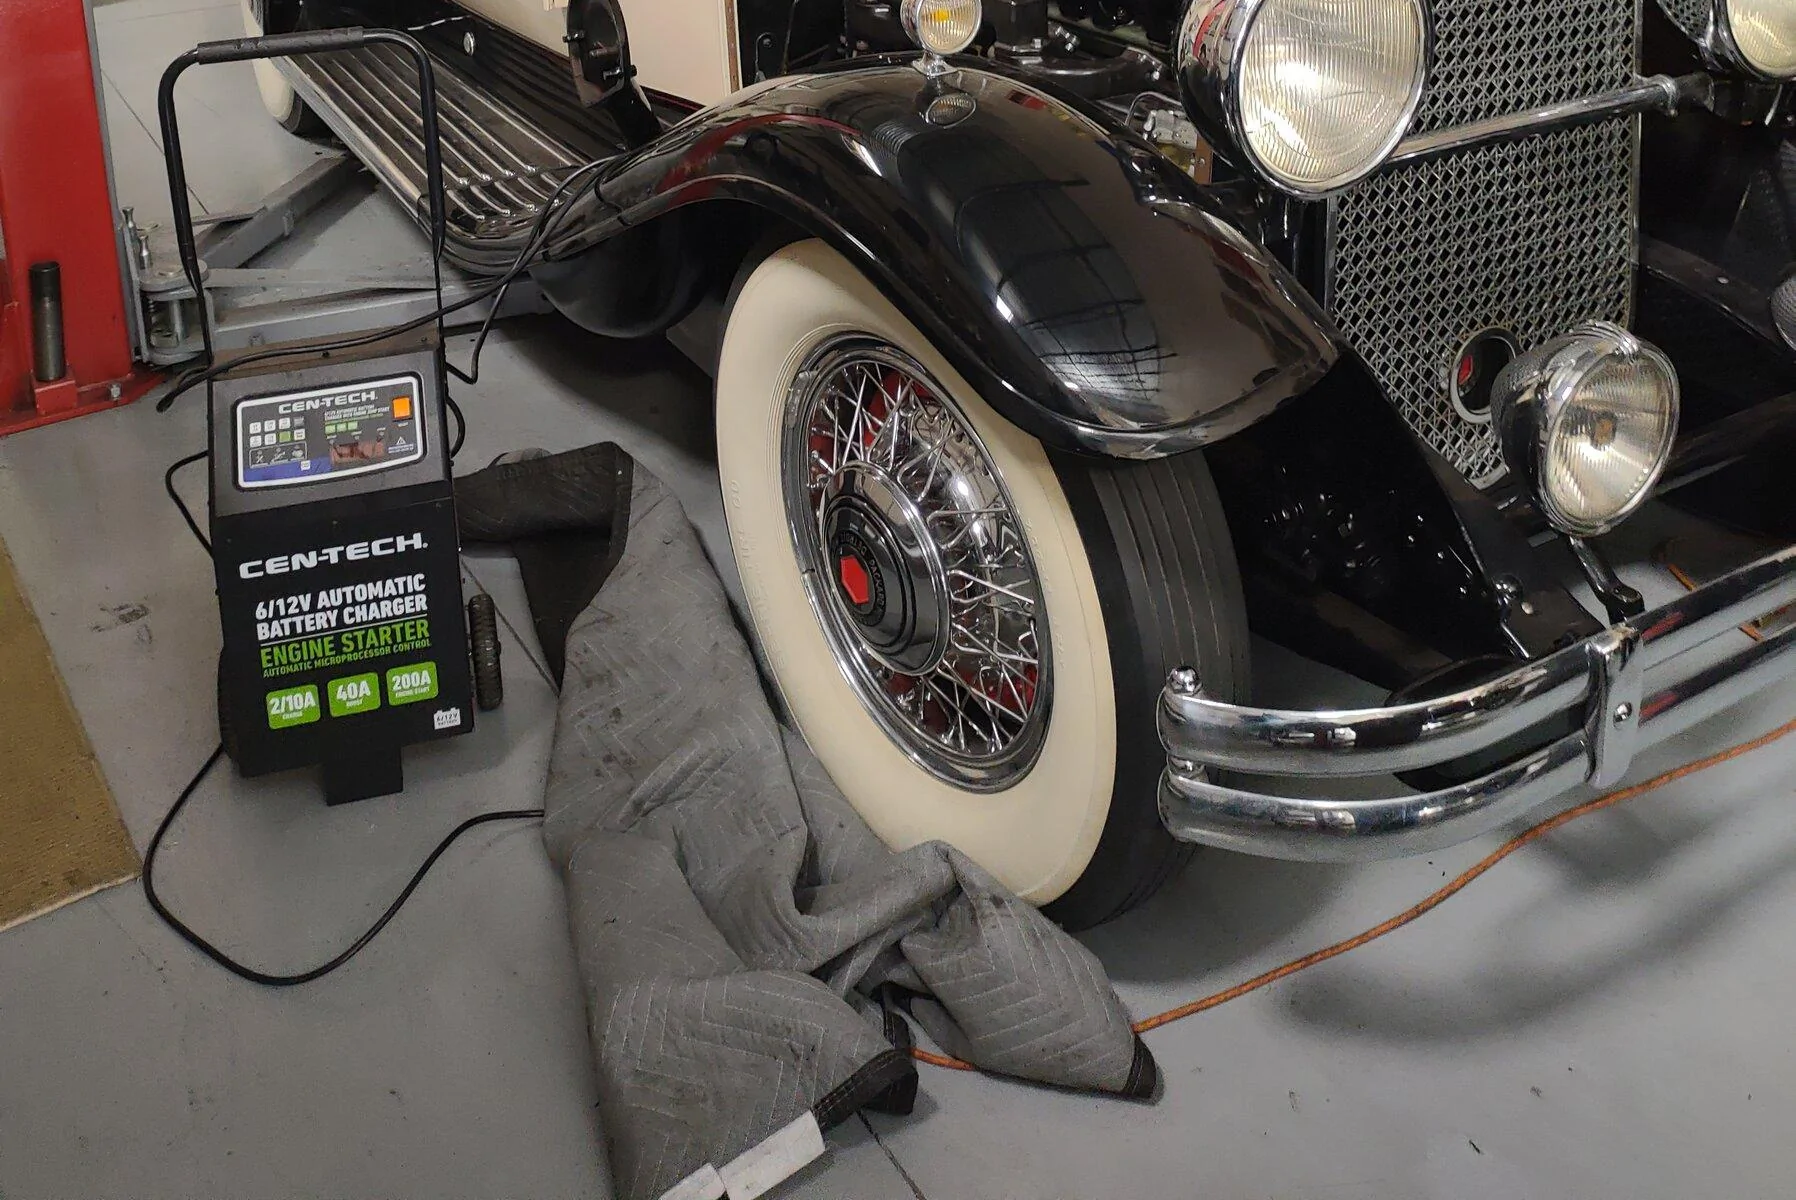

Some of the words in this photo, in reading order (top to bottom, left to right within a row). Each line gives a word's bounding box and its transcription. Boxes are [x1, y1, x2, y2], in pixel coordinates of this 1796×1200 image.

[255, 593, 311, 620] 6/12V
[317, 573, 426, 610] AUTOMATIC
[256, 609, 339, 641] BATTERY
[343, 594, 427, 625] CHARGER
[260, 636, 335, 669] ENGINE
[341, 619, 430, 653] STARTER
[263, 659, 313, 679] AUTOMATIC
[313, 646, 391, 670] MICROPROCESSOR
[393, 639, 432, 655] CONTROL
[336, 680, 371, 701] 40A
[392, 670, 431, 692] 200A
[269, 691, 316, 715] 2/10A
